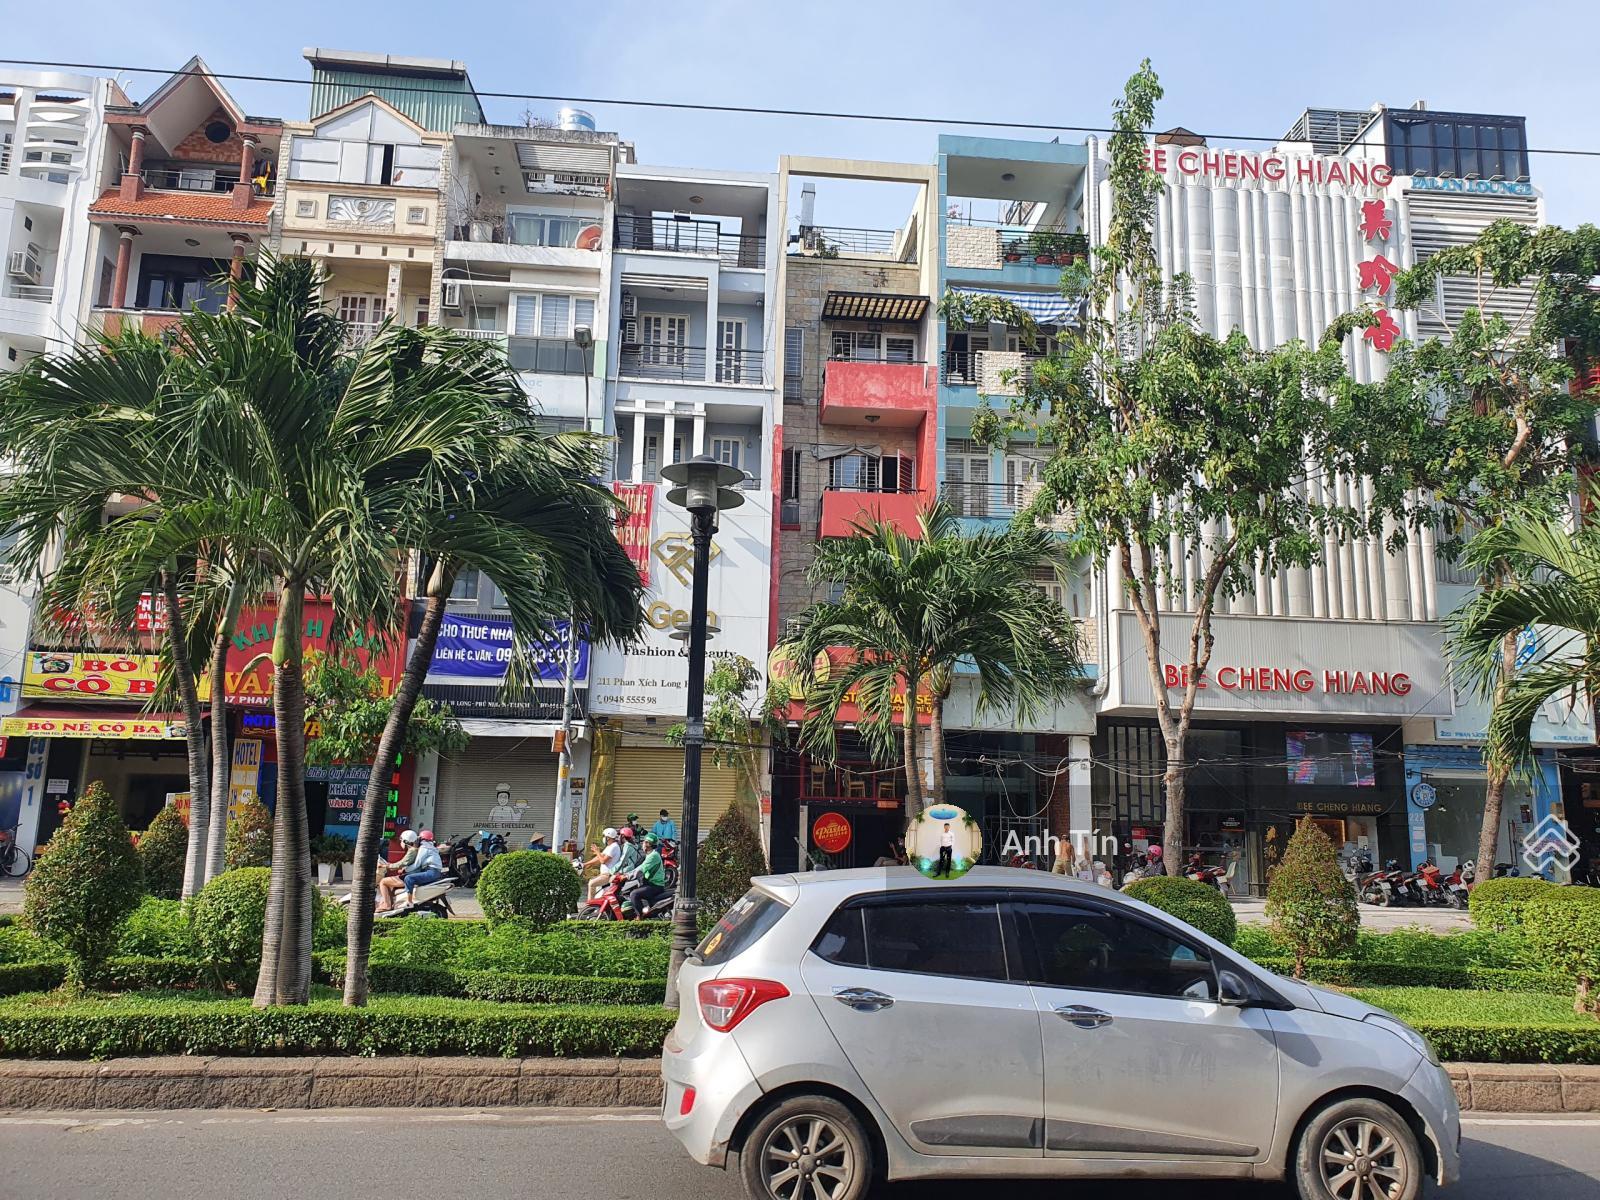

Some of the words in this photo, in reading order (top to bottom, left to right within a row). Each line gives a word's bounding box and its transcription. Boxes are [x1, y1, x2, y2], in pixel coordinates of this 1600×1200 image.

[1178, 151, 1286, 182] CHENG
[1297, 159, 1393, 188] HIANG
[1466, 179, 1533, 196] LOUNGE
[1357, 199, 1399, 352] 美珍香
[460, 624, 488, 640] THUÊ
[490, 627, 513, 641] NHÀ
[436, 647, 454, 660] LIÊN
[455, 649, 466, 662] HỆ
[624, 644, 676, 657] Fashion
[43, 675, 111, 693] CÔ
[127, 680, 157, 694] B
[597, 677, 610, 686] 211
[613, 677, 636, 687] Phan
[638, 678, 658, 688] Xích
[661, 680, 682, 689] Long
[1216, 666, 1315, 694] CHENG
[1323, 670, 1412, 697] HIANG
[603, 696, 625, 705] 0948
[626, 697, 646, 705] 5555
[647, 698, 657, 706] 98
[62, 721, 91, 732] NÉ
[98, 721, 126, 733] CÔ
[132, 725, 161, 734] BA
[235, 742, 258, 765] HOTEL
[27, 786, 34, 806] 1
[329, 781, 359, 796] KHÁCH
[1296, 802, 1313, 810] BEE
[1317, 802, 1348, 811] CHENG
[1352, 803, 1382, 812] HIANG
